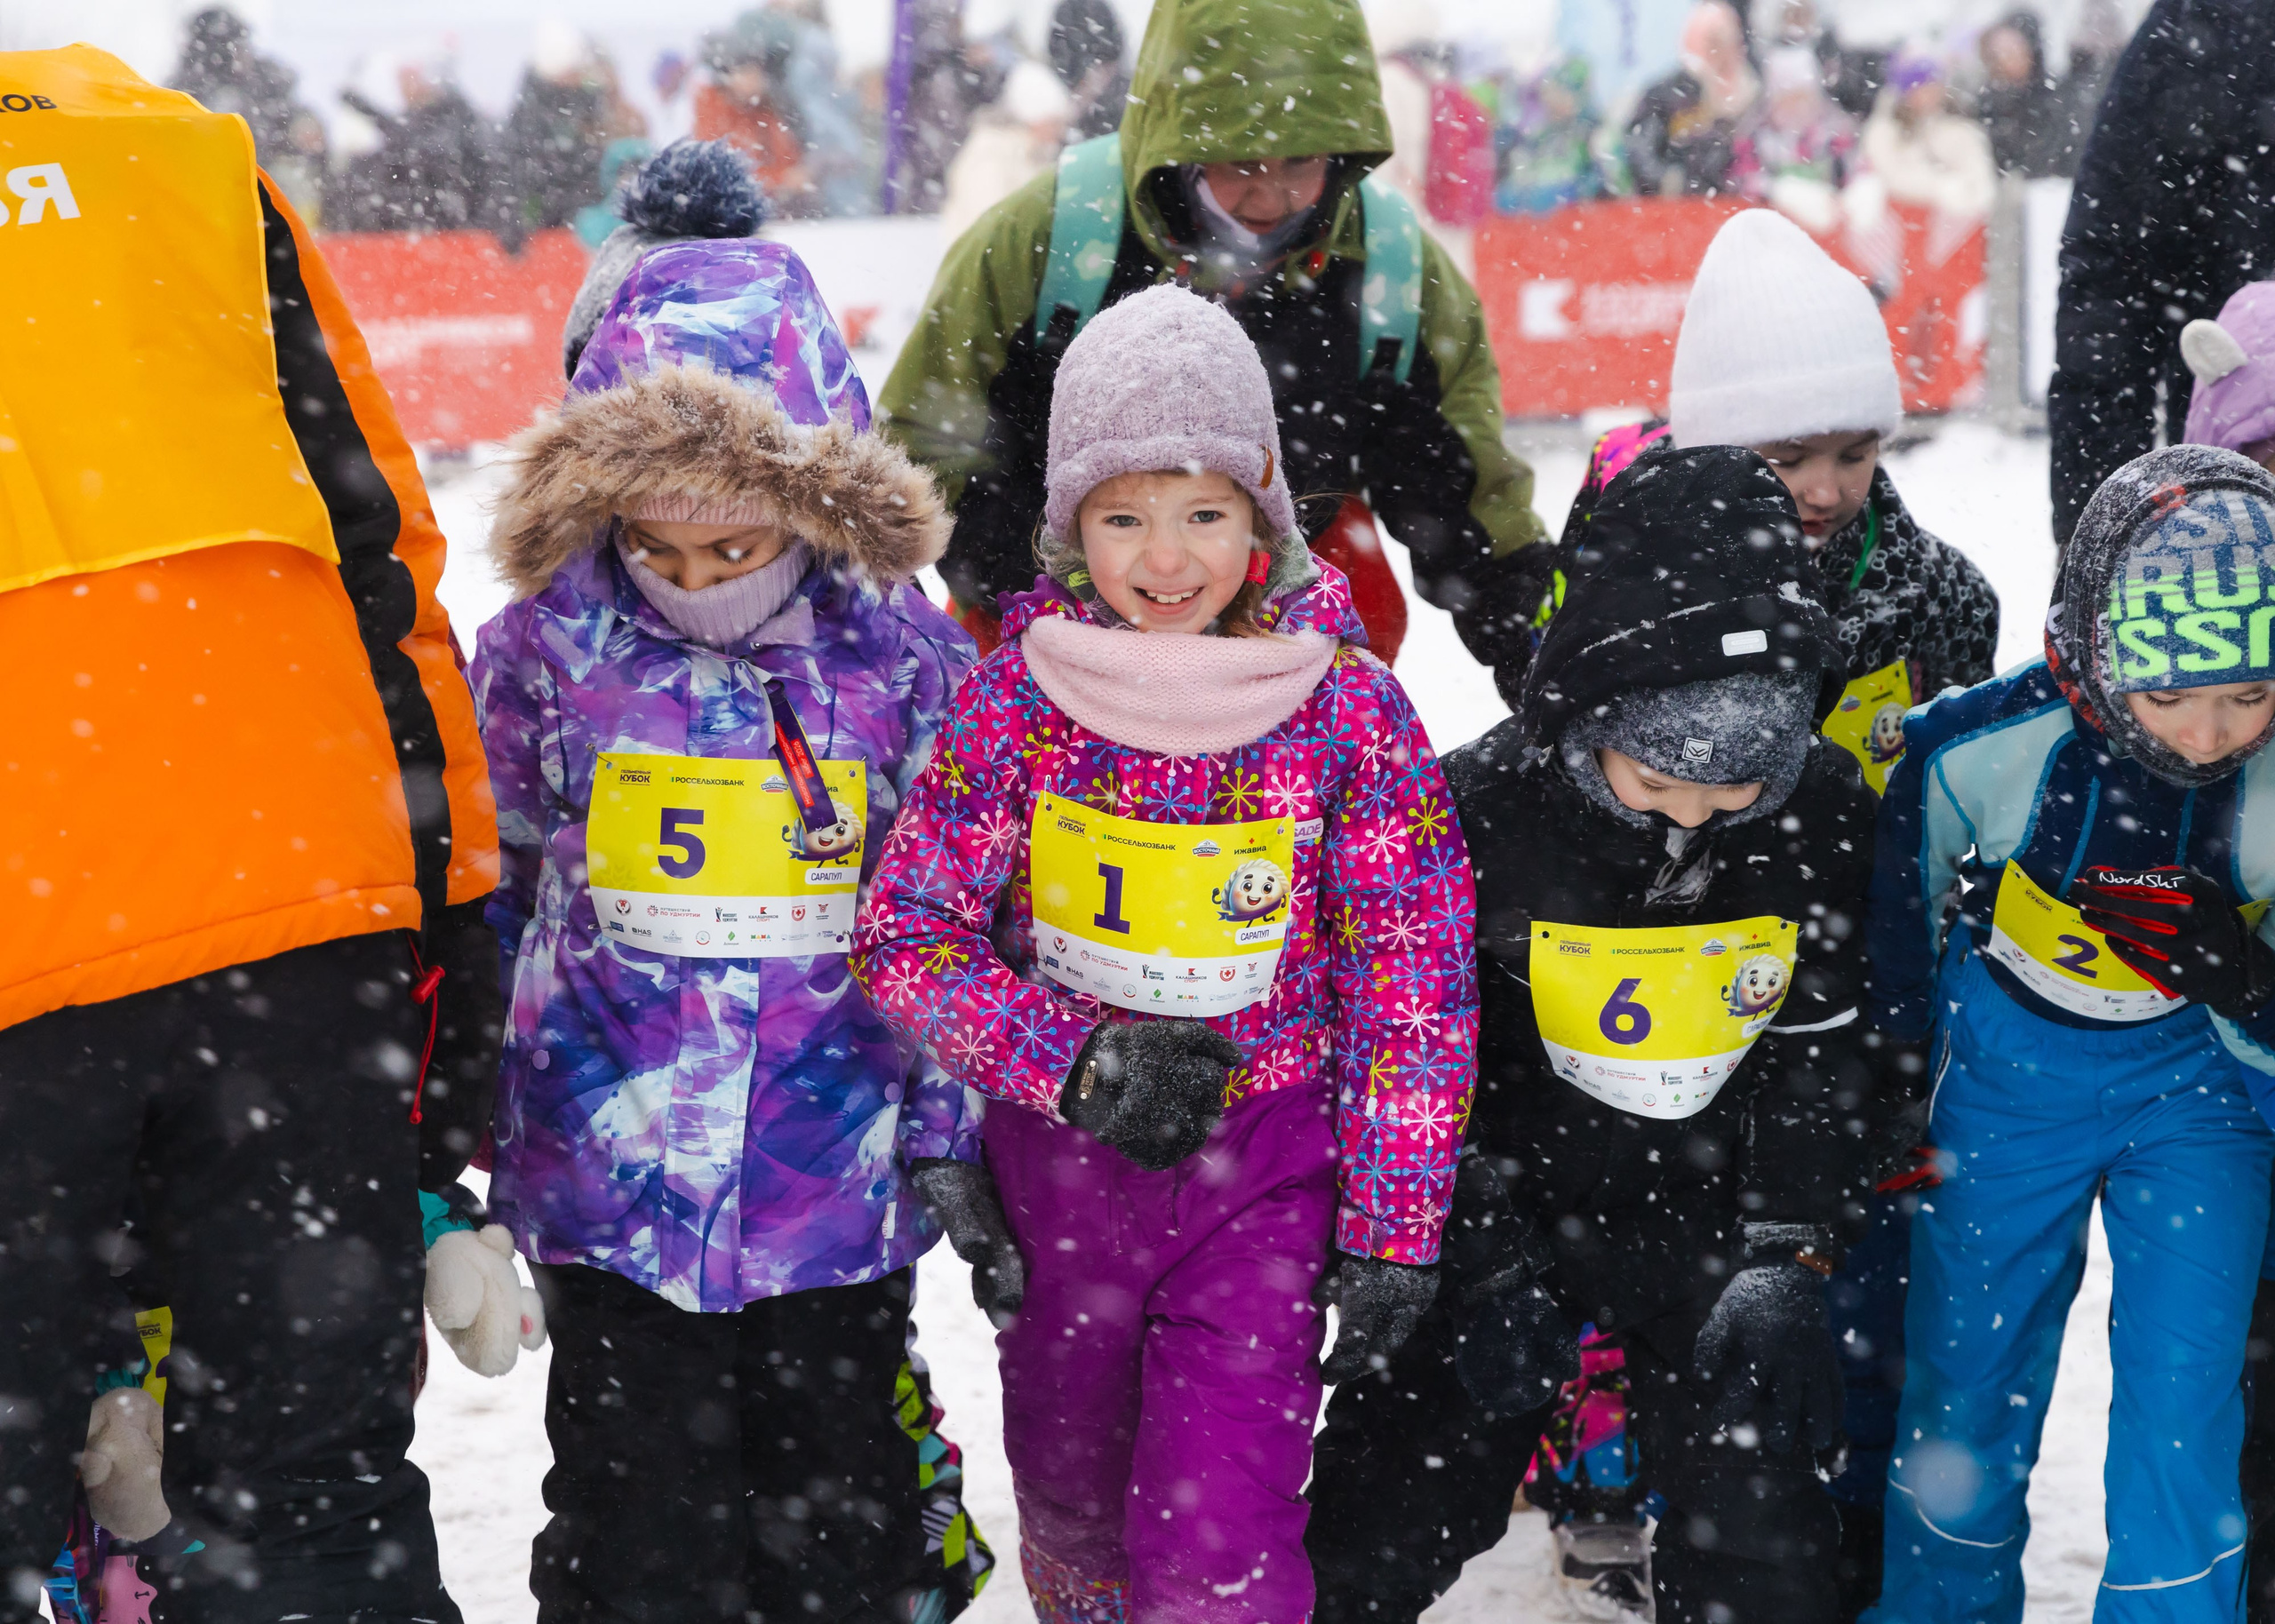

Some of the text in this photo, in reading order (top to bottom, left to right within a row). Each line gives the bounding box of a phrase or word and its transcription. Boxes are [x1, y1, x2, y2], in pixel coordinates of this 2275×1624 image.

[0, 94, 58, 112] ОВ
[0, 163, 82, 227] Я
[794, 741, 805, 758] 2026
[619, 774, 651, 784] КУБОК
[675, 776, 745, 786] РОССЕЛЬХОЗБАНК
[1058, 819, 1085, 835] КУБОК
[658, 808, 706, 879] 5
[1107, 834, 1177, 851] РОССЕЛЬХОЗБАНК
[1233, 845, 1267, 856] ижавиа
[811, 872, 842, 881] САРАПУЛ
[1094, 862, 1130, 935] 1
[1241, 929, 1269, 941] САРАПУЛ
[1560, 944, 1591, 954] КУБОК
[1616, 946, 1685, 955] РОССЕЛЬХОЗБАНК
[1739, 941, 1771, 951] ижавиа
[2051, 934, 2099, 979] 2
[1100, 960, 1129, 971] УДМУРТИИ
[1599, 978, 1651, 1046] 6
[139, 1327, 162, 1336] БОК
